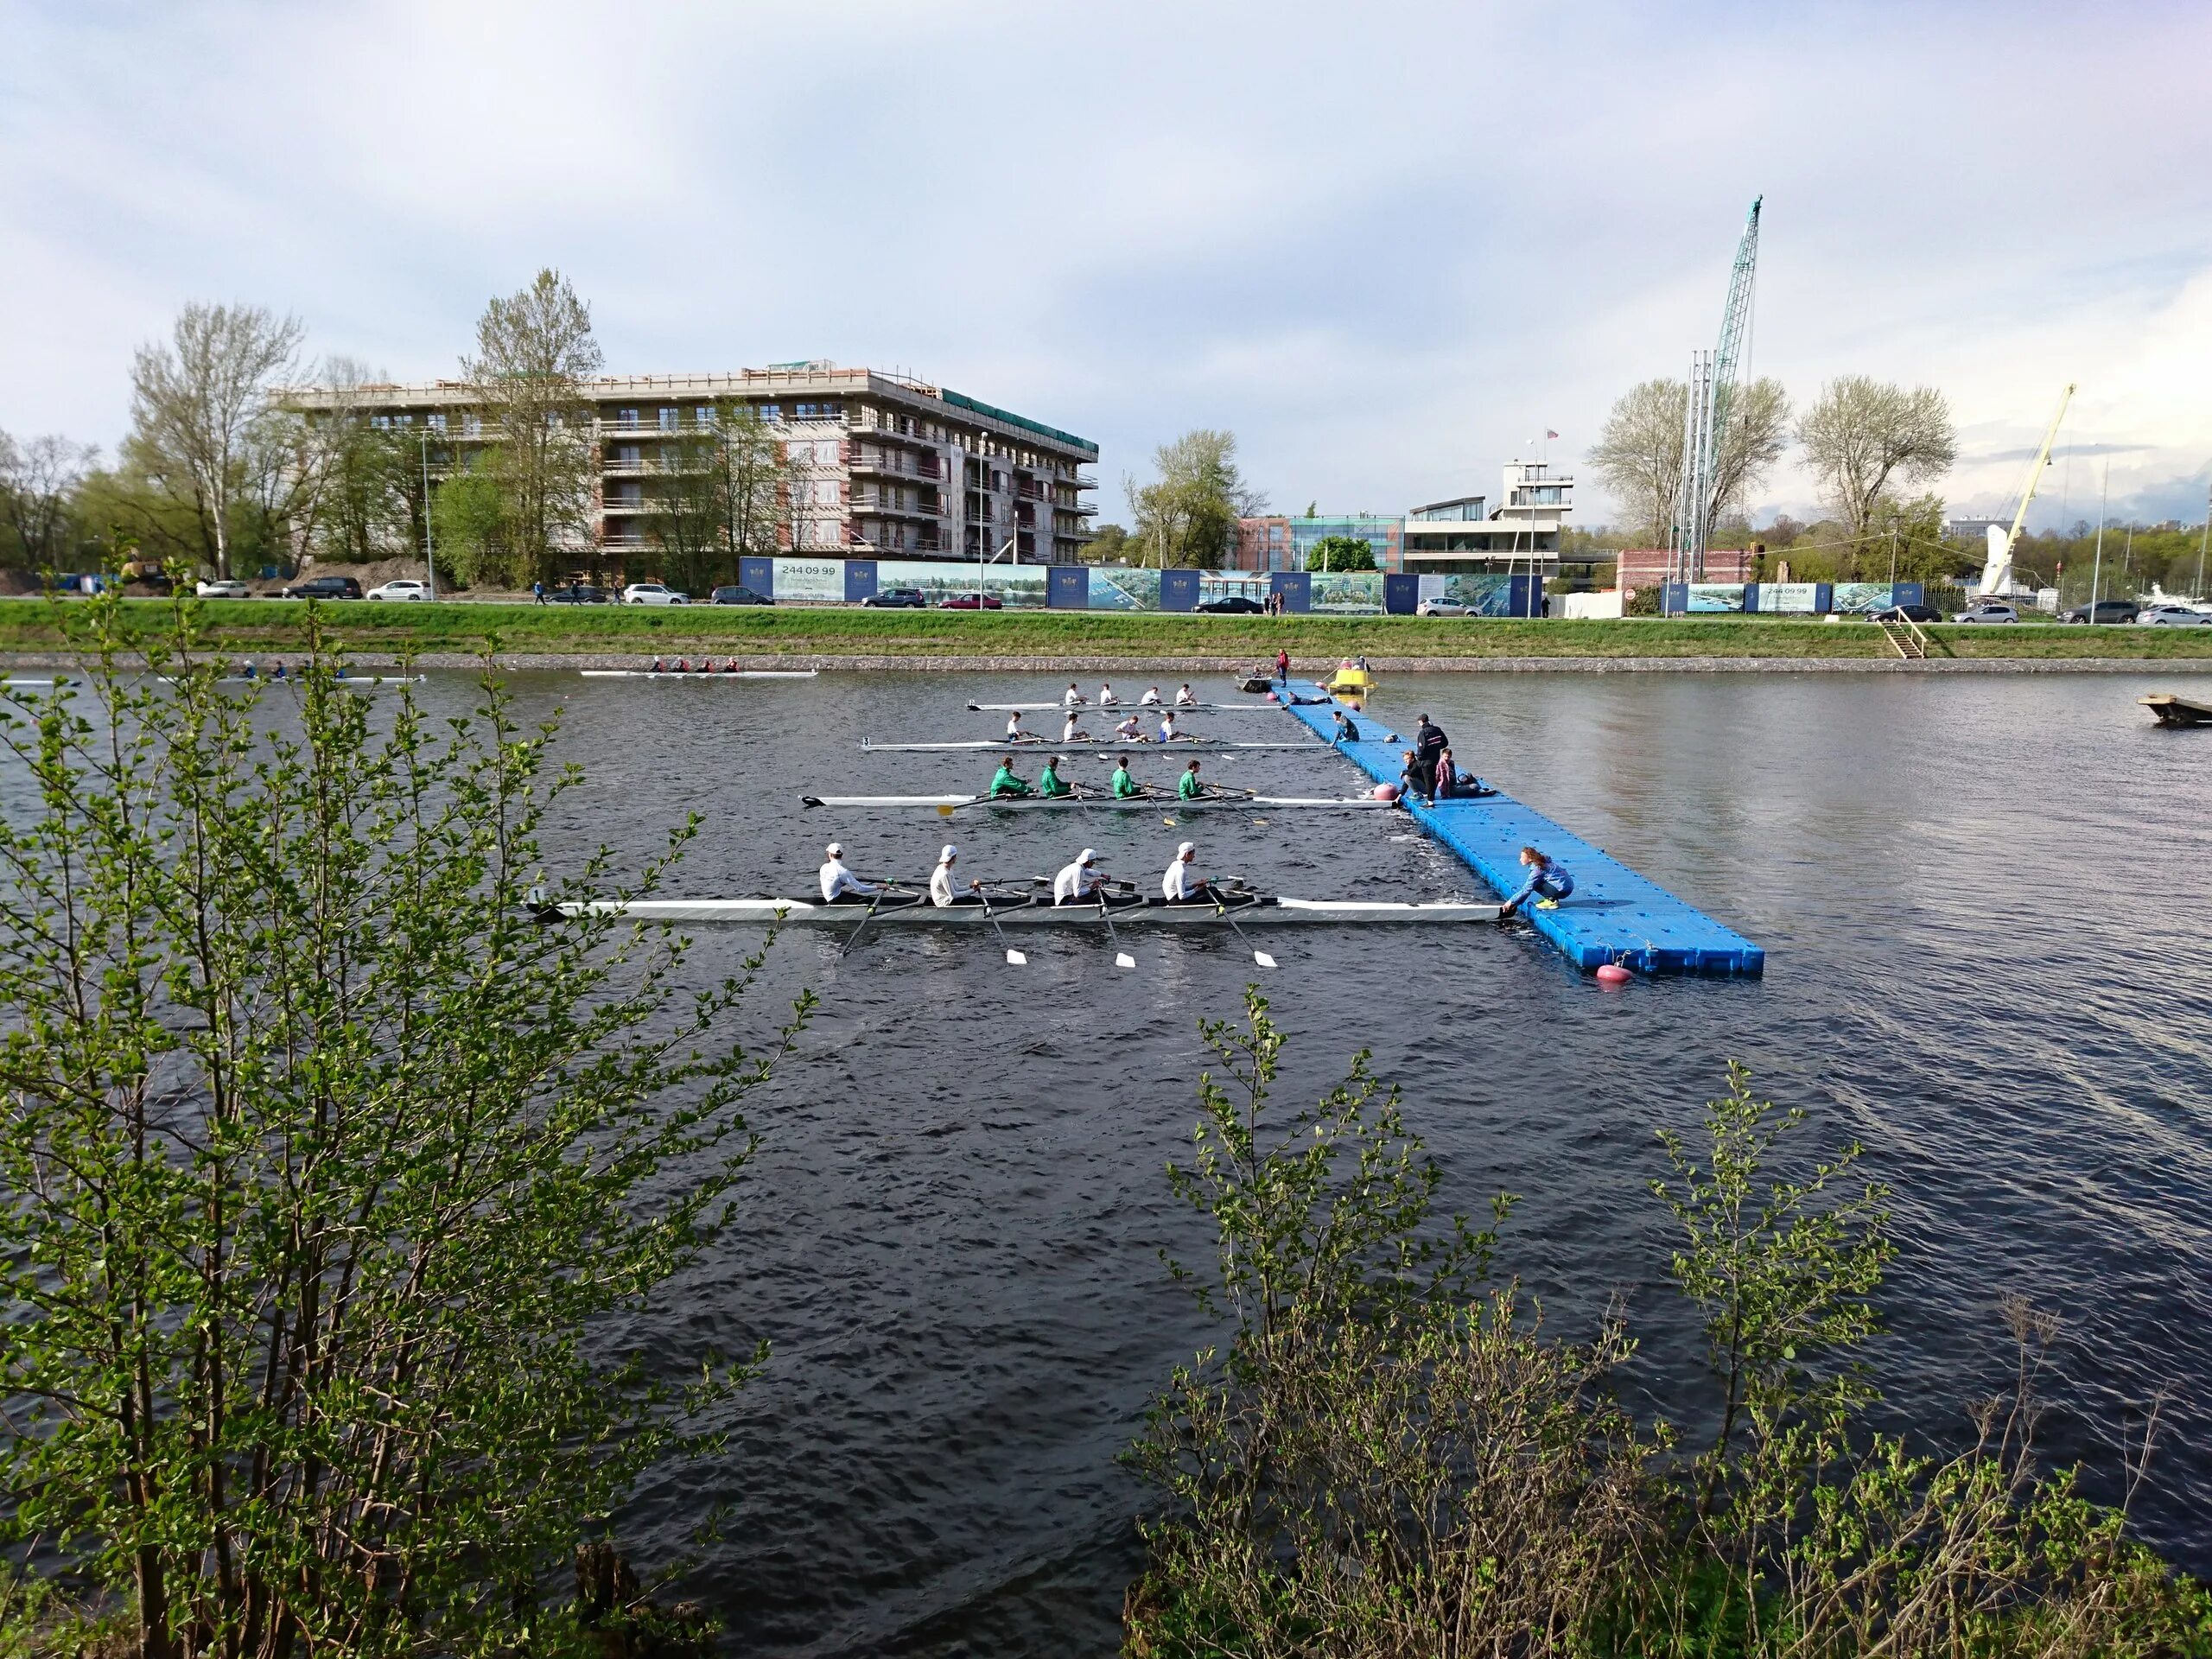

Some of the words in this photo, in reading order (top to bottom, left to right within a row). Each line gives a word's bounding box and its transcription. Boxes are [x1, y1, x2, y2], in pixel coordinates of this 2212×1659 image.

[782, 565, 803, 574] 244
[805, 566, 819, 575] 09
[822, 567, 836, 575] 99
[864, 737, 869, 746] 3
